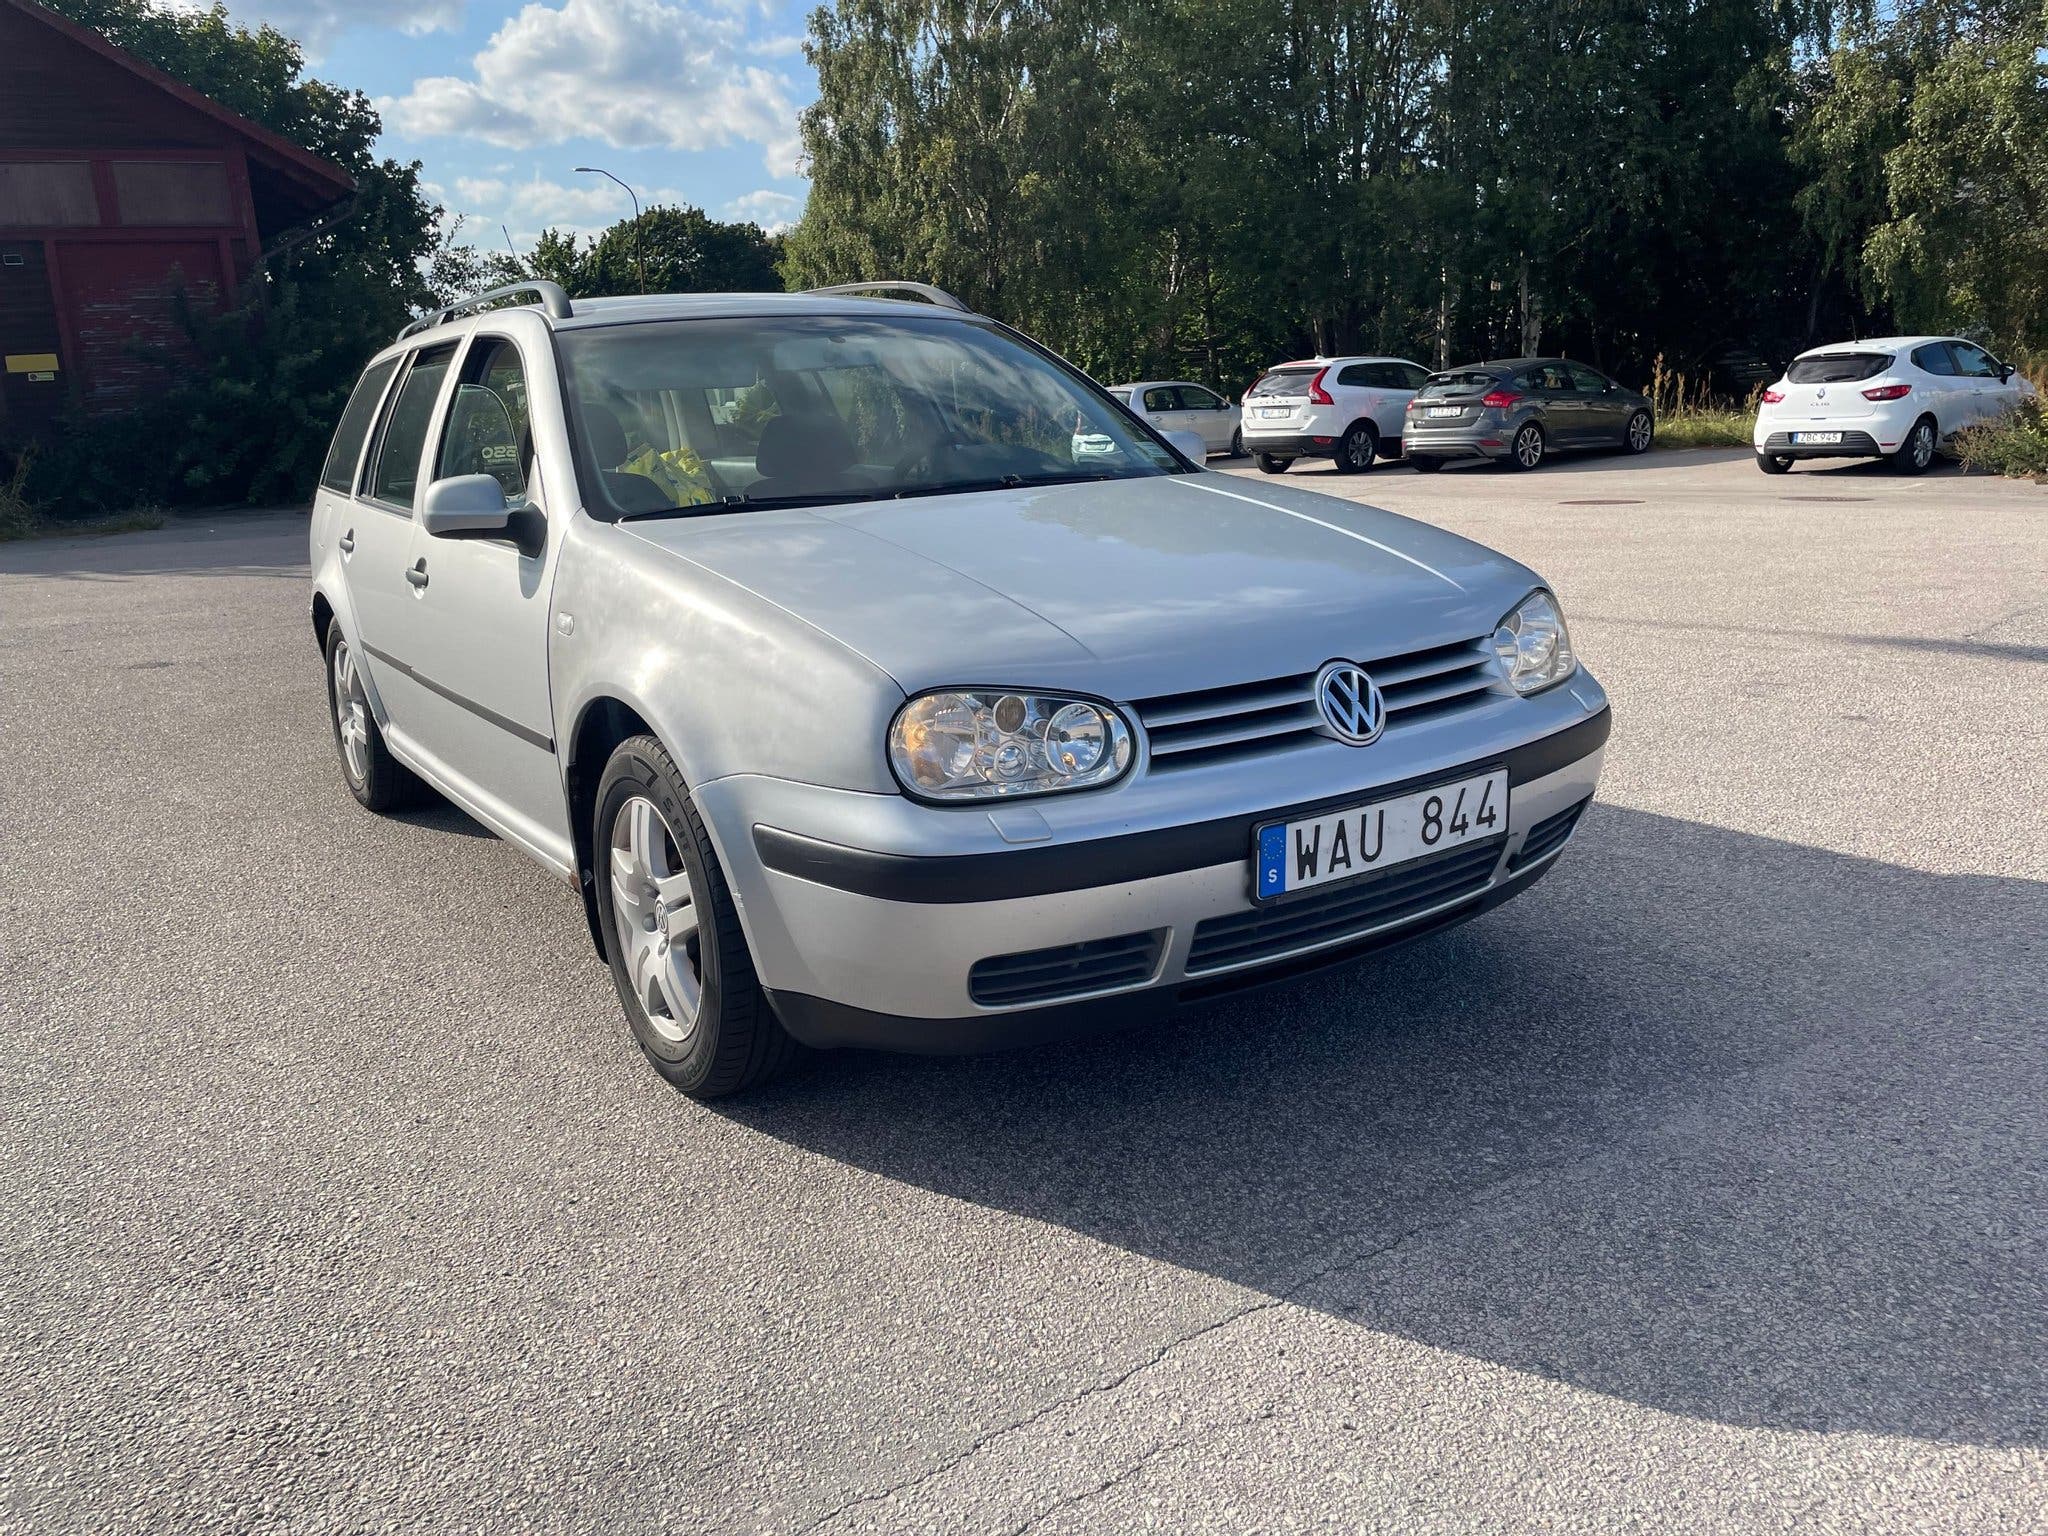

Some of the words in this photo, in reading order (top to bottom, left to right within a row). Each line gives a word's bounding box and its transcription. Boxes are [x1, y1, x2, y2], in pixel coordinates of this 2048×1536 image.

[1322, 666, 1382, 741] VW
[1295, 809, 1384, 880] WAU
[1421, 780, 1496, 846] 844
[1268, 868, 1278, 884] S
